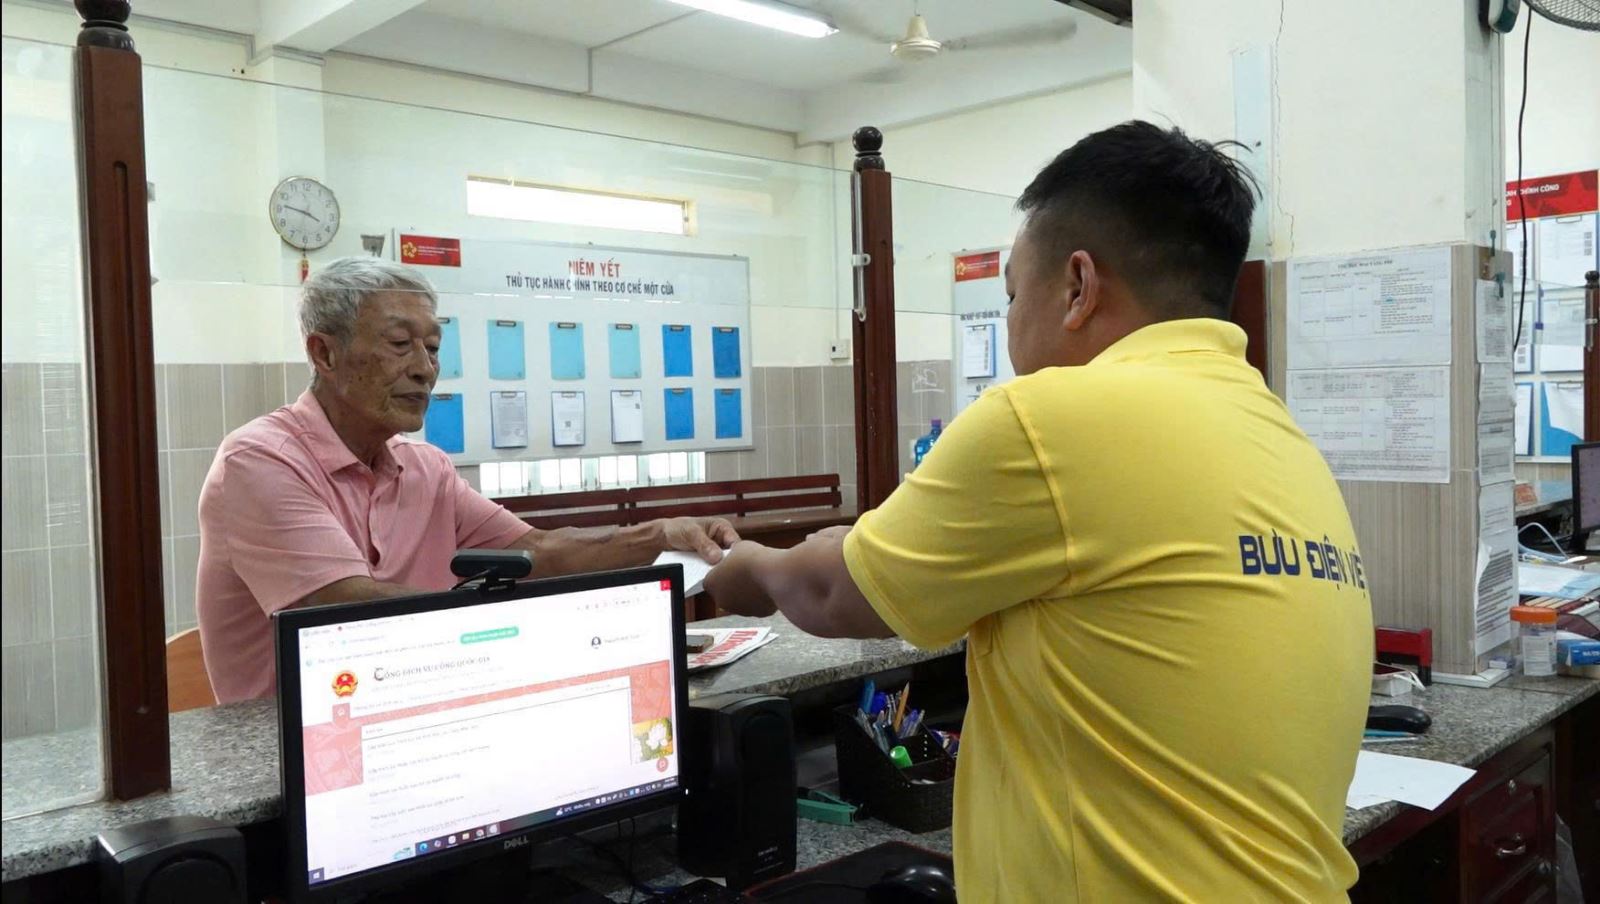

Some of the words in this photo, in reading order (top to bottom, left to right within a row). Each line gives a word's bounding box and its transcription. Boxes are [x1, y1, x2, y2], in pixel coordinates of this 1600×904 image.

[568, 258, 595, 276] NIÊM
[600, 257, 620, 278] YẾT
[506, 271, 523, 288] THỦ
[524, 276, 541, 291] TỤC
[542, 275, 565, 291] HÀNH
[592, 280, 613, 293] THEO
[615, 280, 626, 294] CƠ
[627, 278, 642, 294] CHẾ
[644, 281, 659, 296] MỘT
[1304, 534, 1348, 591] ĐIỆN
[504, 835, 529, 850] DELL
